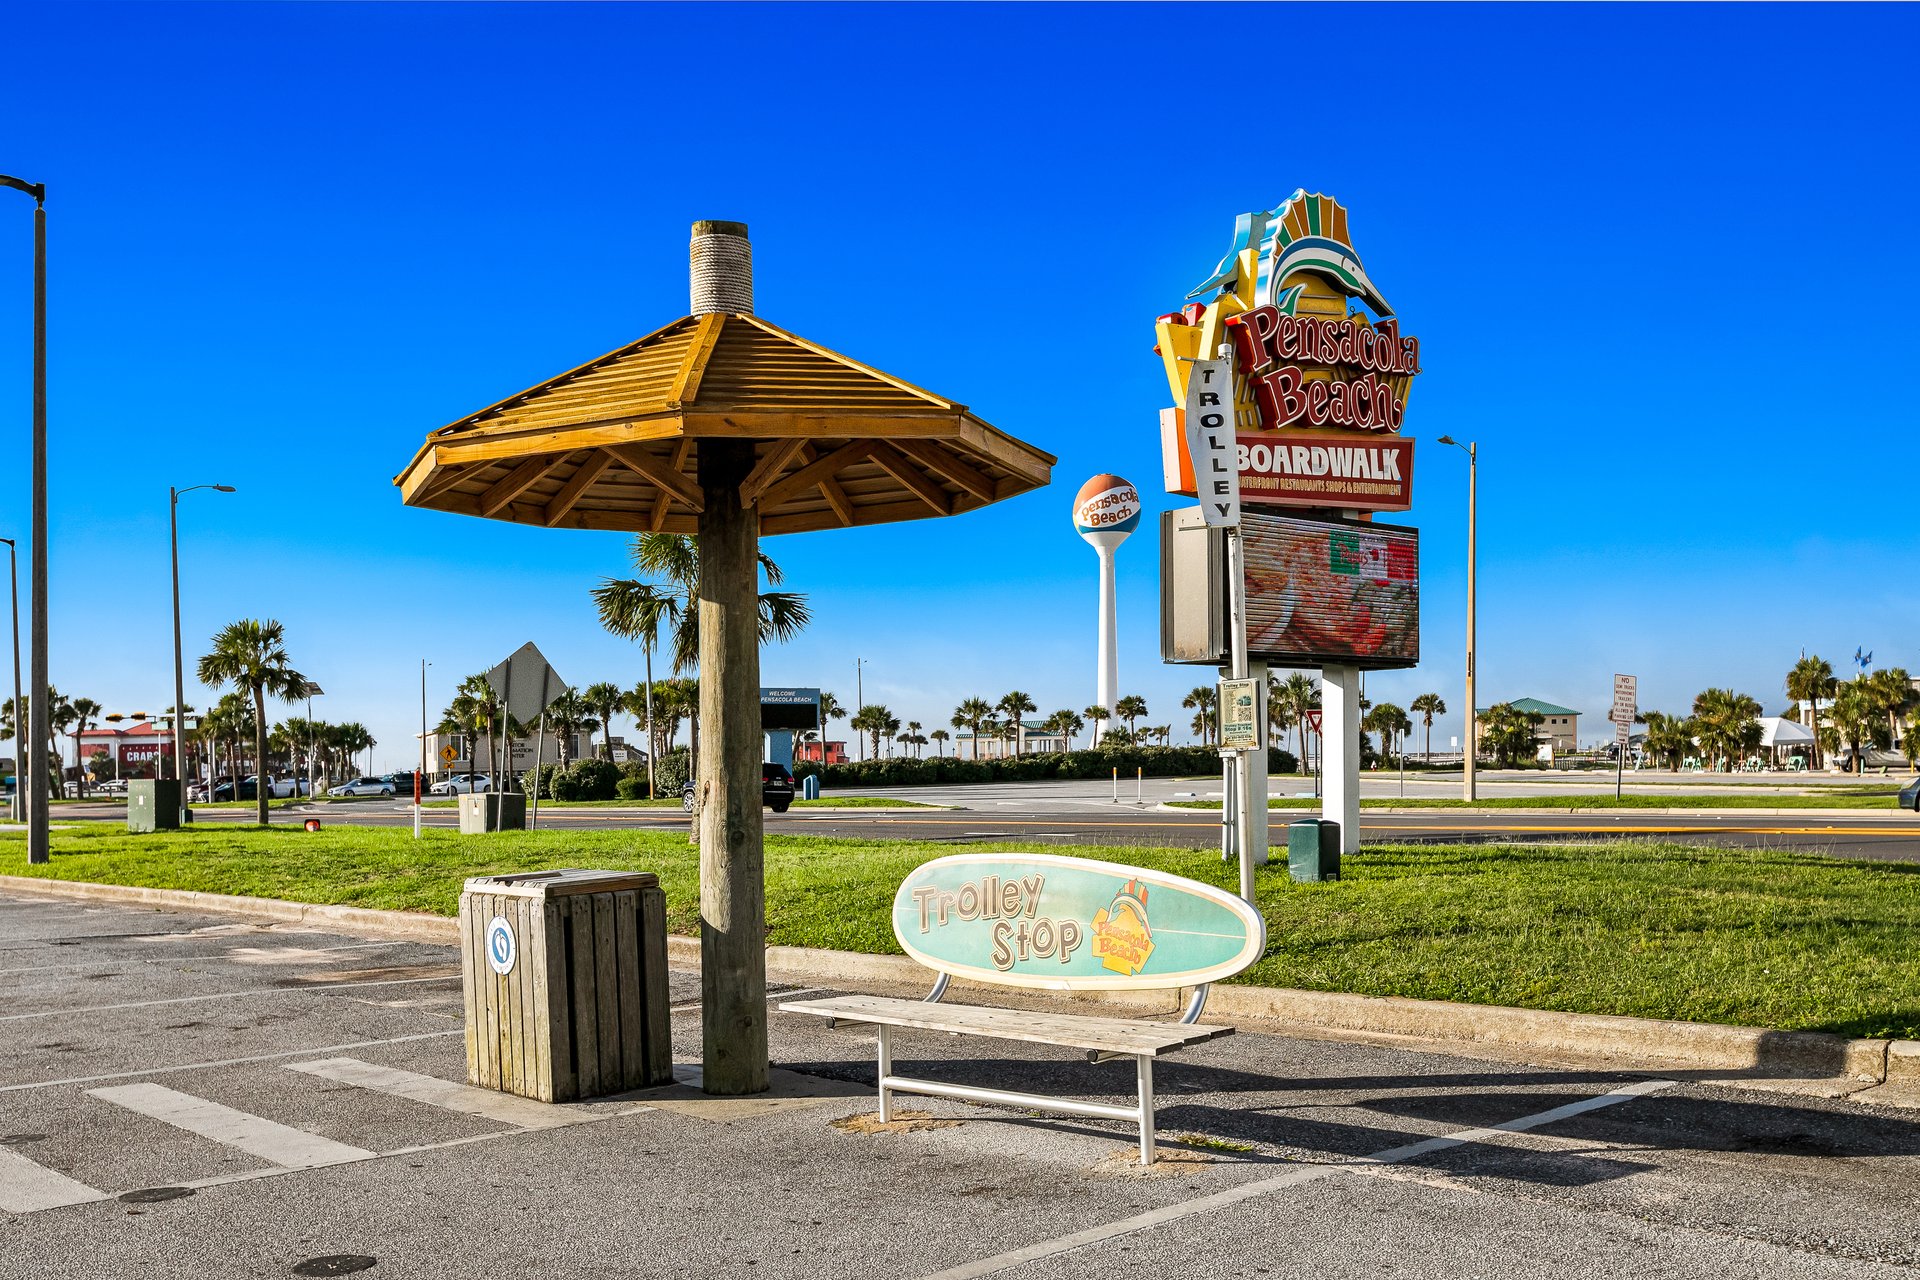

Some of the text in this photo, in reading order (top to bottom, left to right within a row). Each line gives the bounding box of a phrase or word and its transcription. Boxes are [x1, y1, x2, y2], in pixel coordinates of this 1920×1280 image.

[1239, 304, 1423, 376] Pensacola
[1263, 365, 1405, 433] Beach
[1199, 369, 1231, 518] TROLLEY
[1236, 444, 1402, 482] BOARDWALK
[1280, 477, 1325, 492] RESTAURANTS
[1325, 480, 1347, 494] SHOPS
[1346, 481, 1353, 494] &
[1352, 482, 1402, 496] ENTERTAINMENT
[1089, 505, 1132, 526] Beach
[911, 873, 1046, 934] Trolley
[990, 918, 1083, 971] Stop
[1097, 921, 1150, 952] Pensacola
[1098, 937, 1141, 965] Beach
